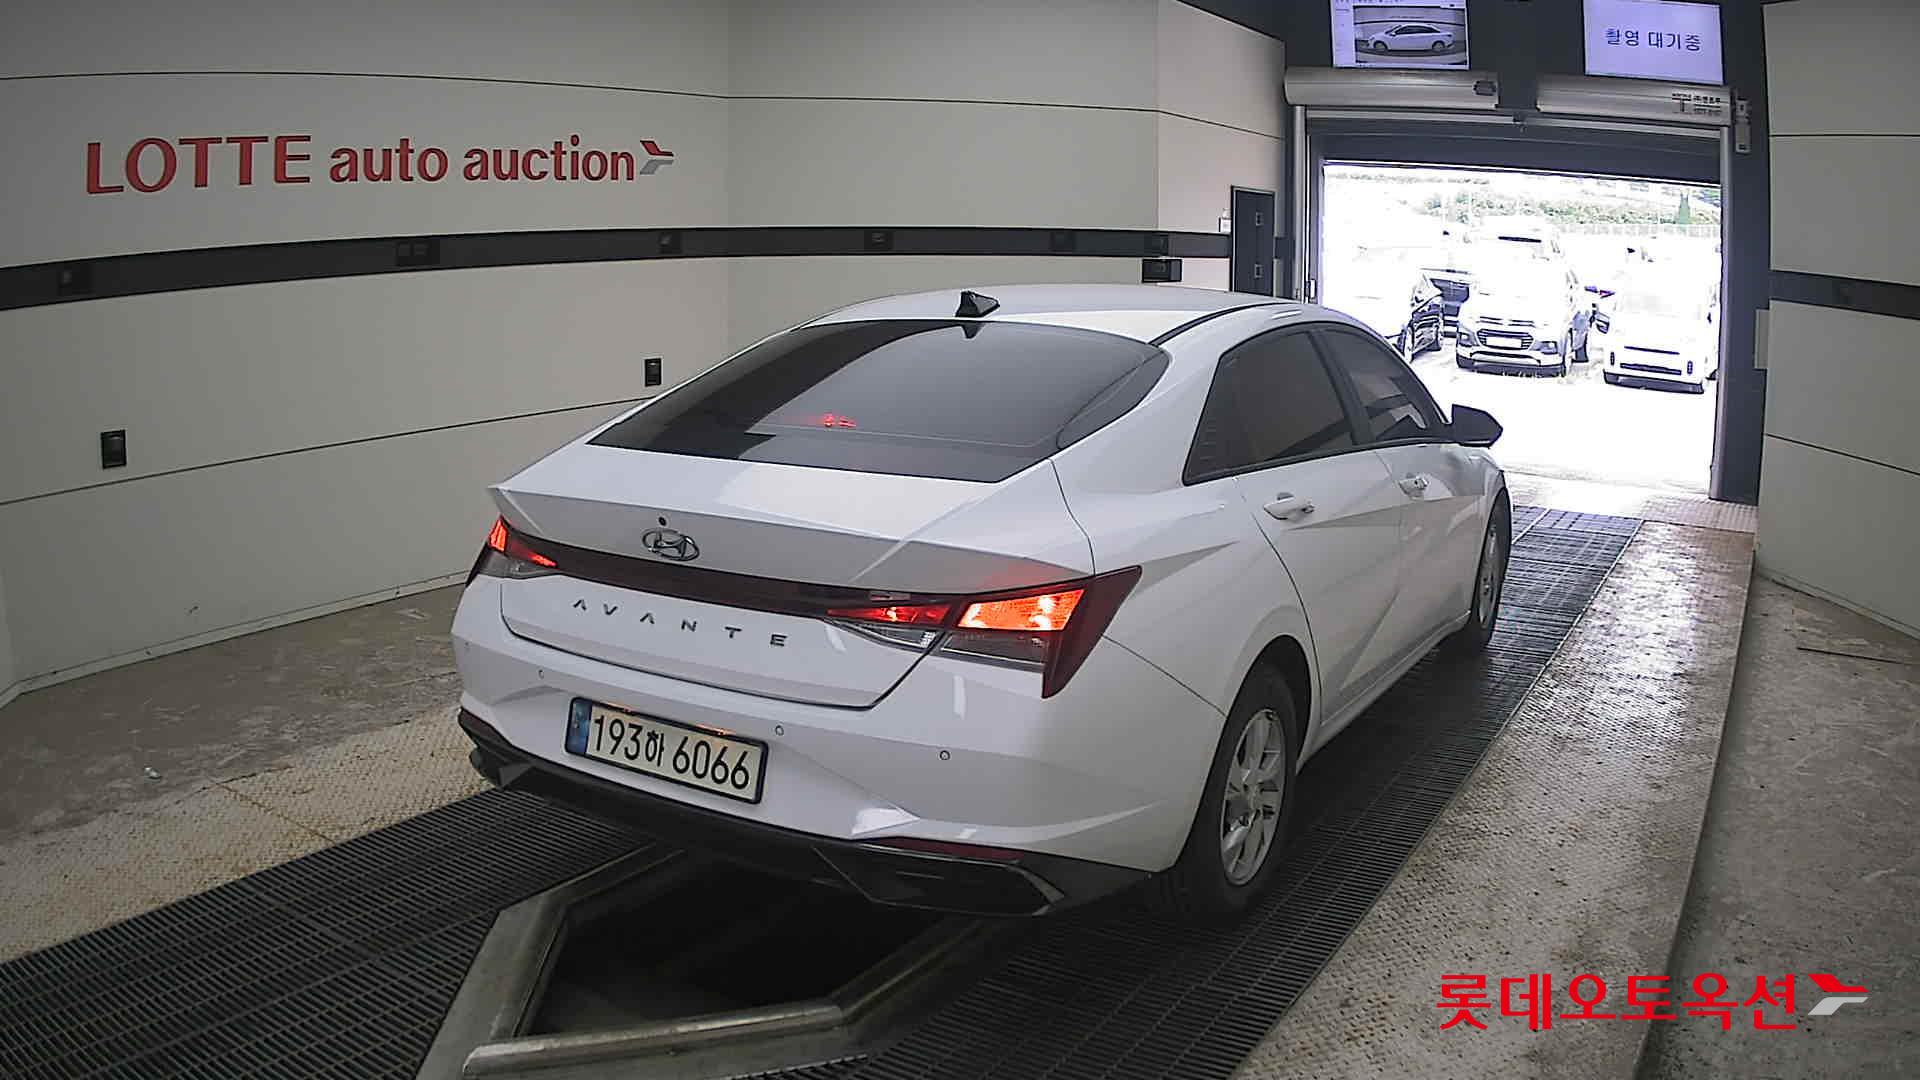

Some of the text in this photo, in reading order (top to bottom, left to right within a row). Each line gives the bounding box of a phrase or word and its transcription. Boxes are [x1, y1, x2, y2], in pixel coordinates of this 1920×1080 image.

[86, 134, 636, 194] LOTTE auto auction
[573, 598, 789, 648] AVANTE
[672, 735, 750, 791] 6066
